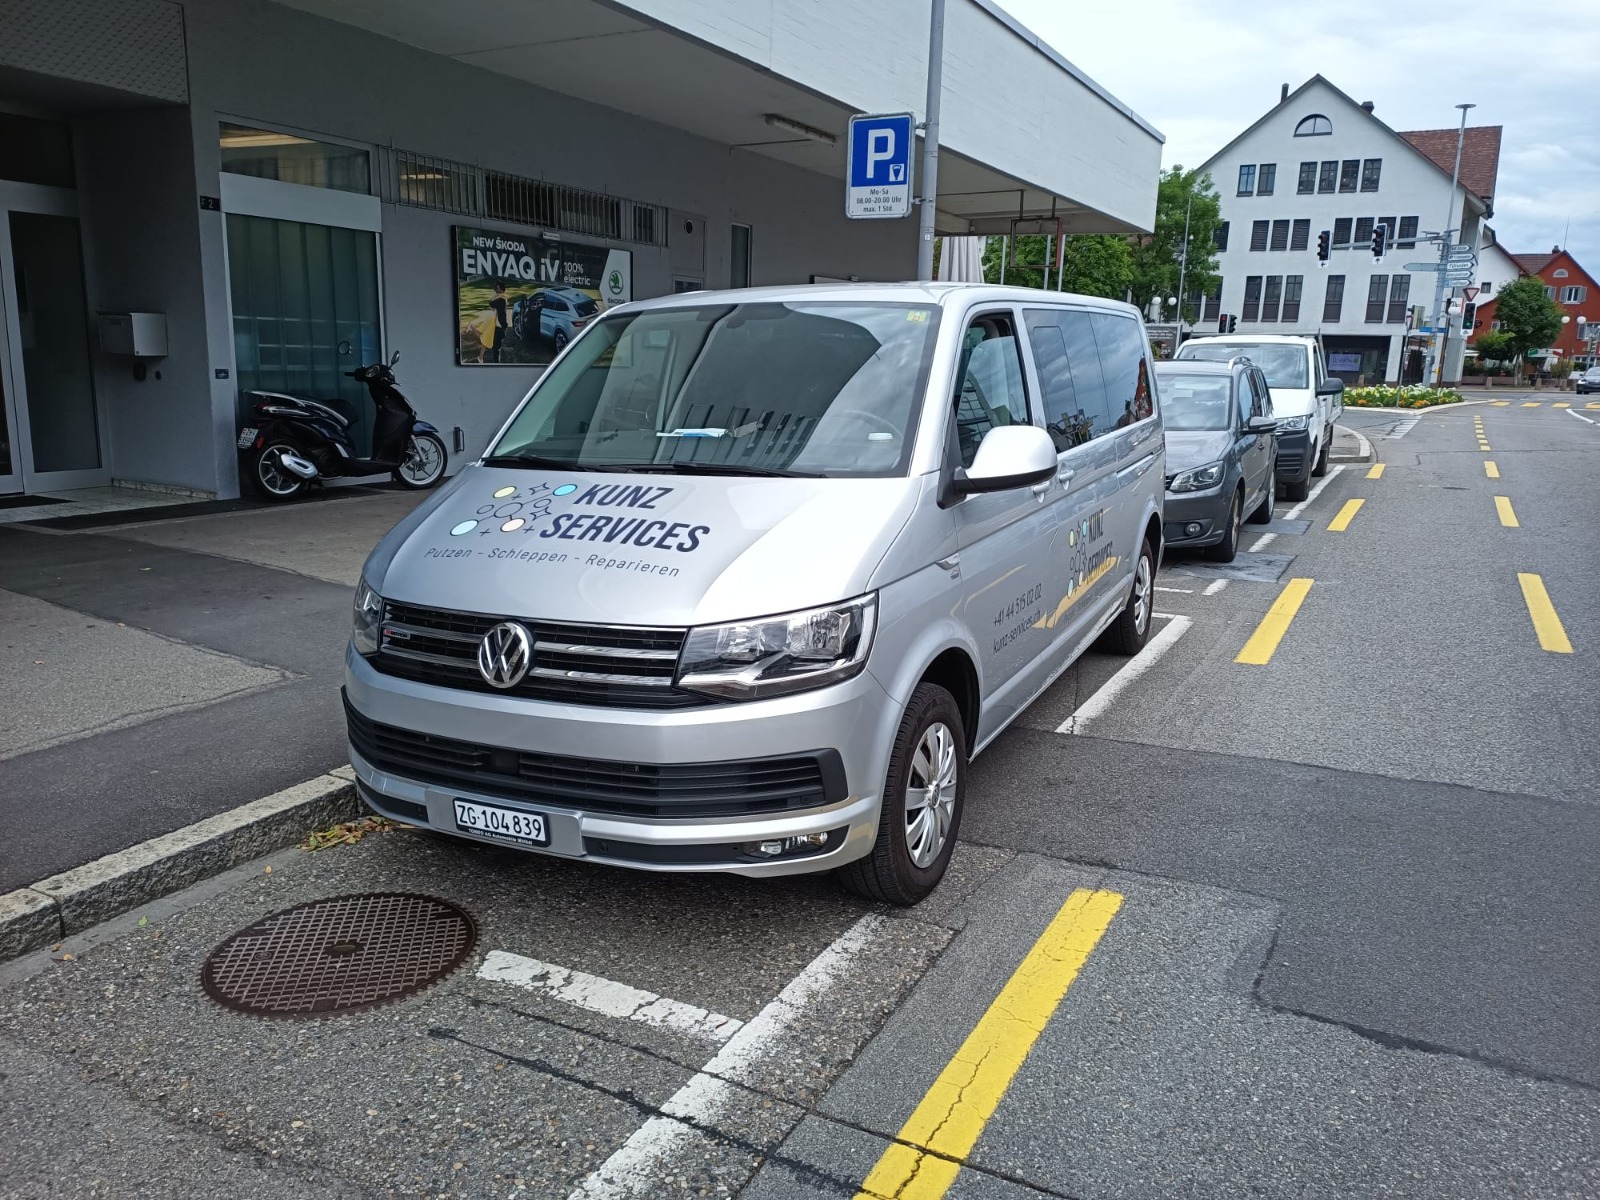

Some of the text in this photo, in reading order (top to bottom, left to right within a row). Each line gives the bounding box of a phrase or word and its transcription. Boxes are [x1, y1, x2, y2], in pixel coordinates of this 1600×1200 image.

[866, 128, 895, 178] P
[891, 195, 902, 203] Uhr
[473, 236, 525, 253] NEW ŠKODA
[463, 249, 560, 283] ENYAQ iV
[563, 261, 584, 274] 100%
[563, 274, 592, 287] electric
[573, 483, 674, 510] KUNZ
[539, 513, 710, 553] SERVICES
[1088, 508, 1104, 545] KUNZ
[424, 547, 471, 559] Putzen
[488, 547, 567, 564] Schleppen
[585, 553, 681, 578] Reparieren
[1006, 601, 1015, 620] 44
